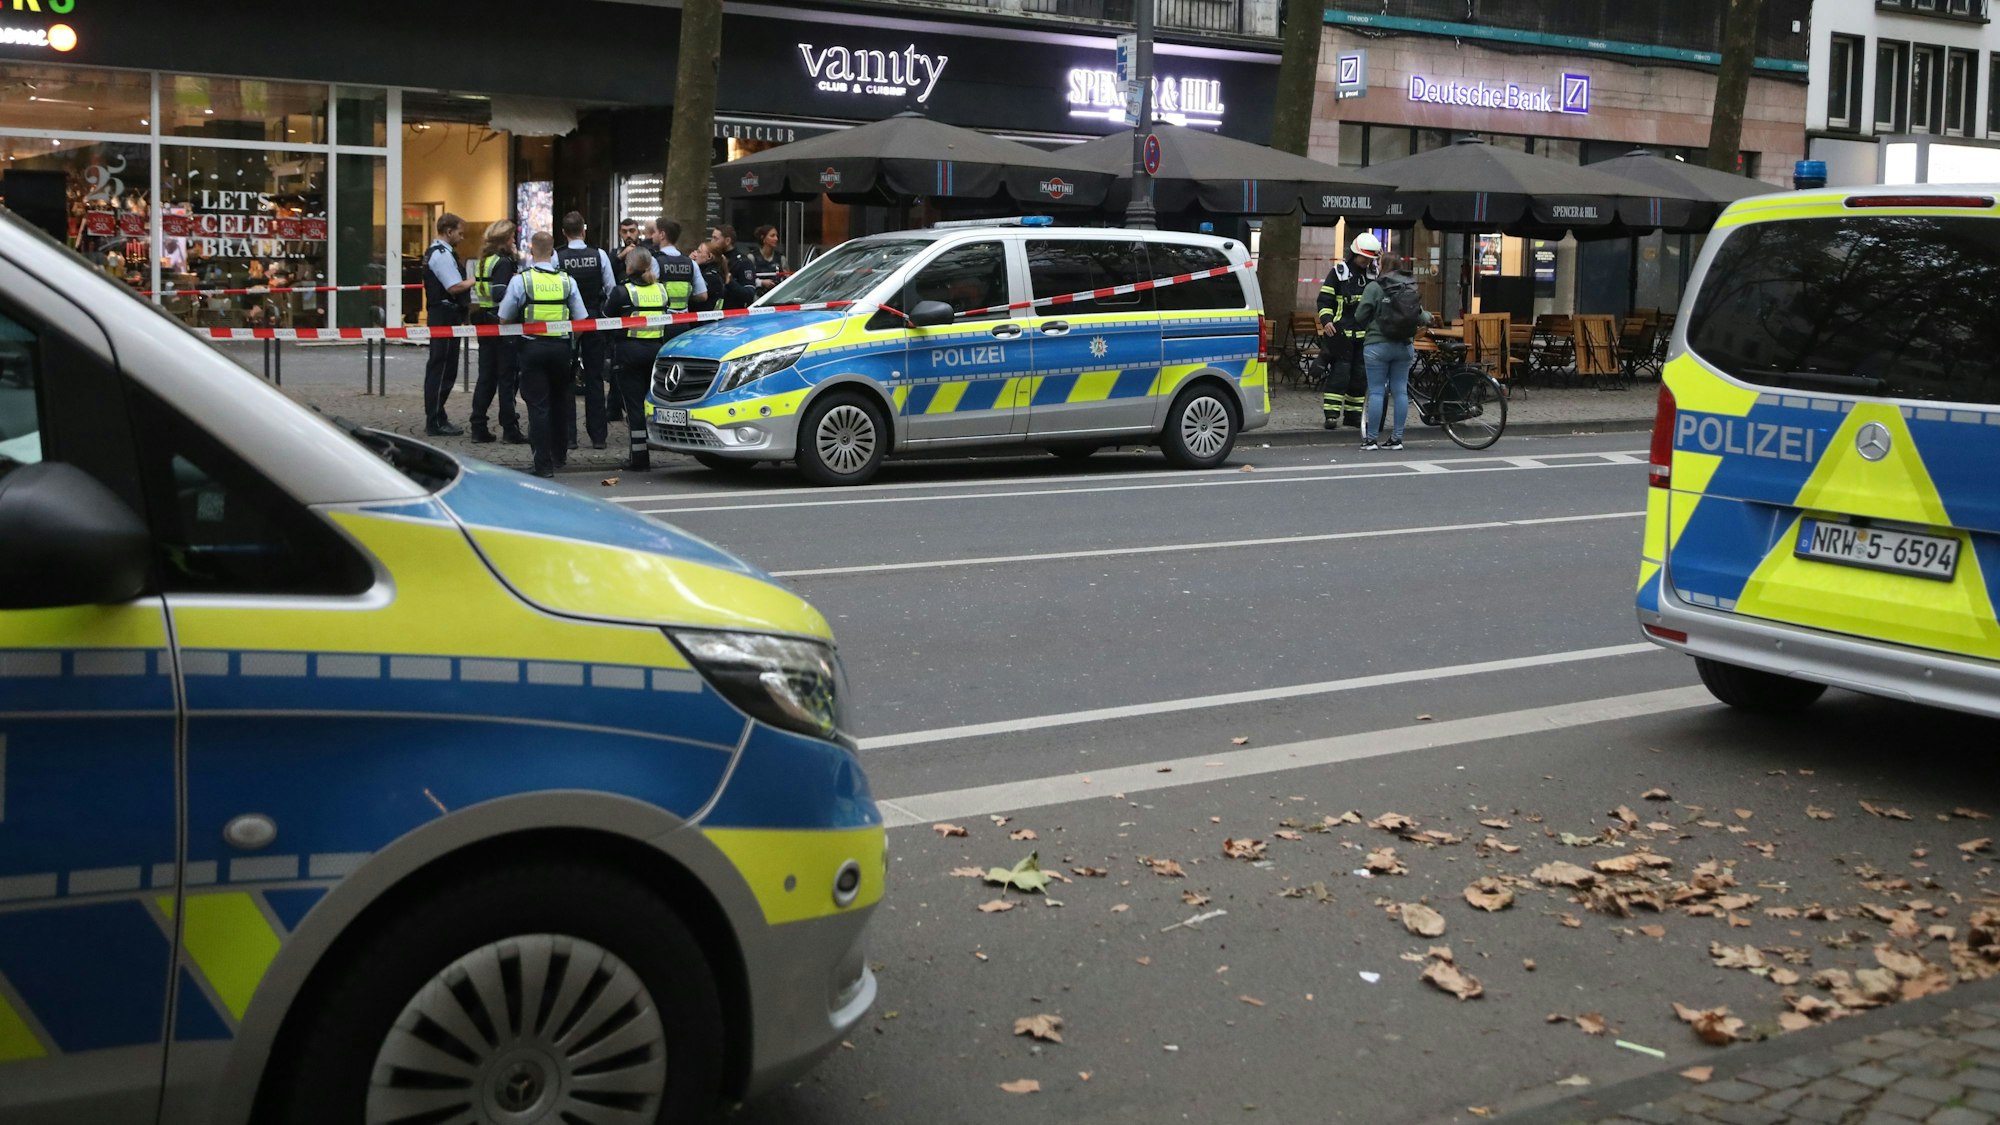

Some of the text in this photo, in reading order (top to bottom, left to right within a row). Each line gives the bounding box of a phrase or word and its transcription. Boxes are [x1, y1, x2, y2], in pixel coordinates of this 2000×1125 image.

[798, 43, 949, 103] vanity
[818, 80, 848, 92] CLUB
[1409, 75, 1553, 112] Deutsche Bank
[1161, 77, 1179, 111] &
[1180, 77, 1225, 114] HILL
[713, 123, 796, 143] IGHTCLUB
[820, 174, 840, 183] MARTINI
[1041, 183, 1072, 193] MARTINI
[1322, 195, 1351, 208] SPENCER
[1357, 198, 1372, 209] HILL
[1391, 204, 1404, 215] HILL
[1553, 205, 1579, 218] SPENCER
[1584, 207, 1598, 218] HILL
[201, 213, 269, 235] CELE
[564, 256, 598, 269] POLIZEI
[664, 263, 692, 275] POLIZEI
[931, 345, 1006, 368] POLIZEI
[1676, 413, 1815, 463] POLIZEI
[1811, 525, 1857, 556] NRW
[1866, 533, 1952, 571] 5-6594
